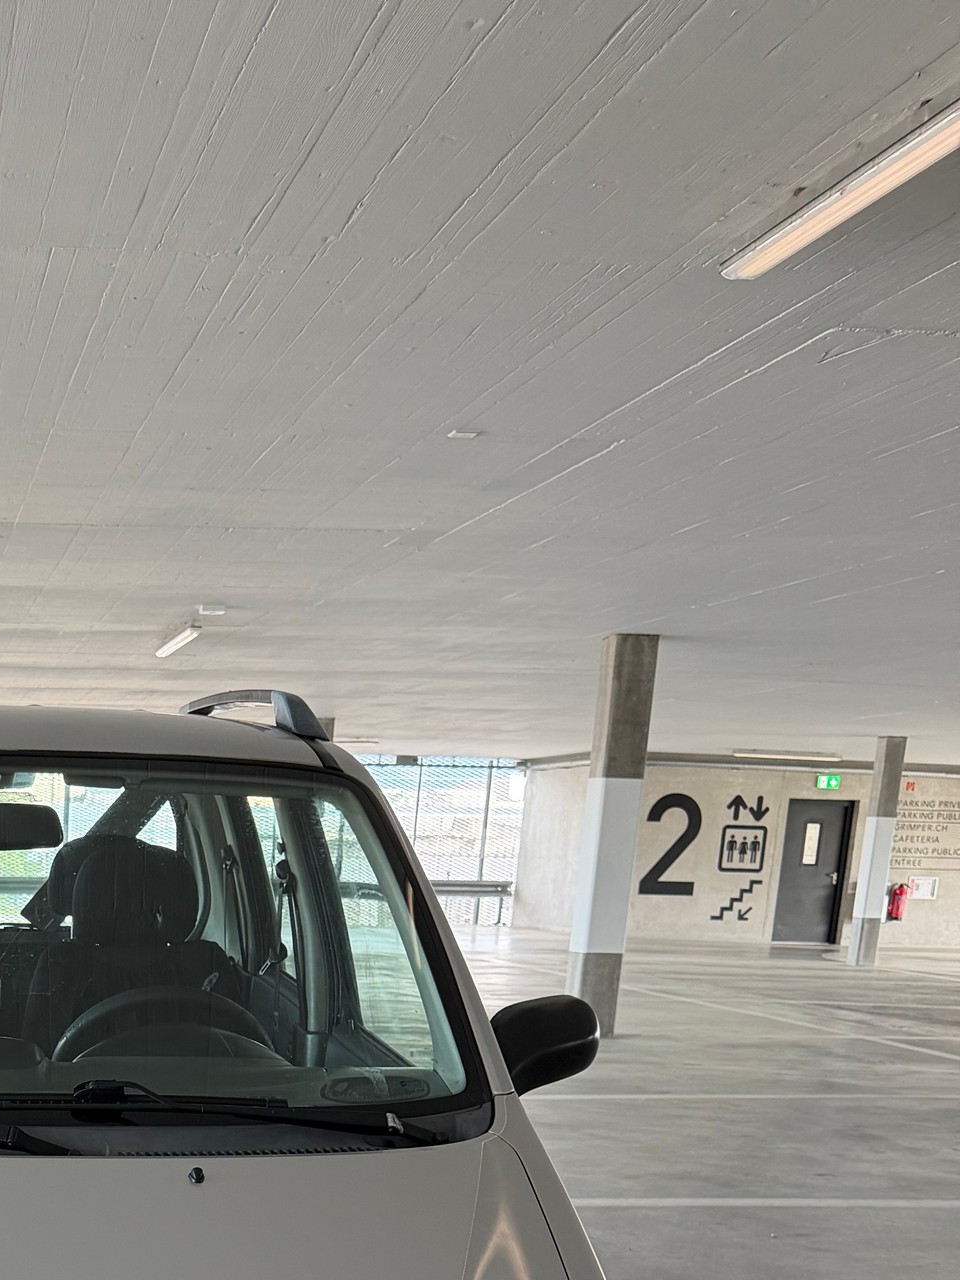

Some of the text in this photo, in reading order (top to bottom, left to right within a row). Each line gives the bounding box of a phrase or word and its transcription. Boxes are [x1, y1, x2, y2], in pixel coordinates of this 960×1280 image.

[894, 823, 948, 832] GRIMPER.CH
[893, 834, 940, 843] CAFETERIA
[638, 793, 702, 896] 2
[891, 846, 929, 855] PARKING
